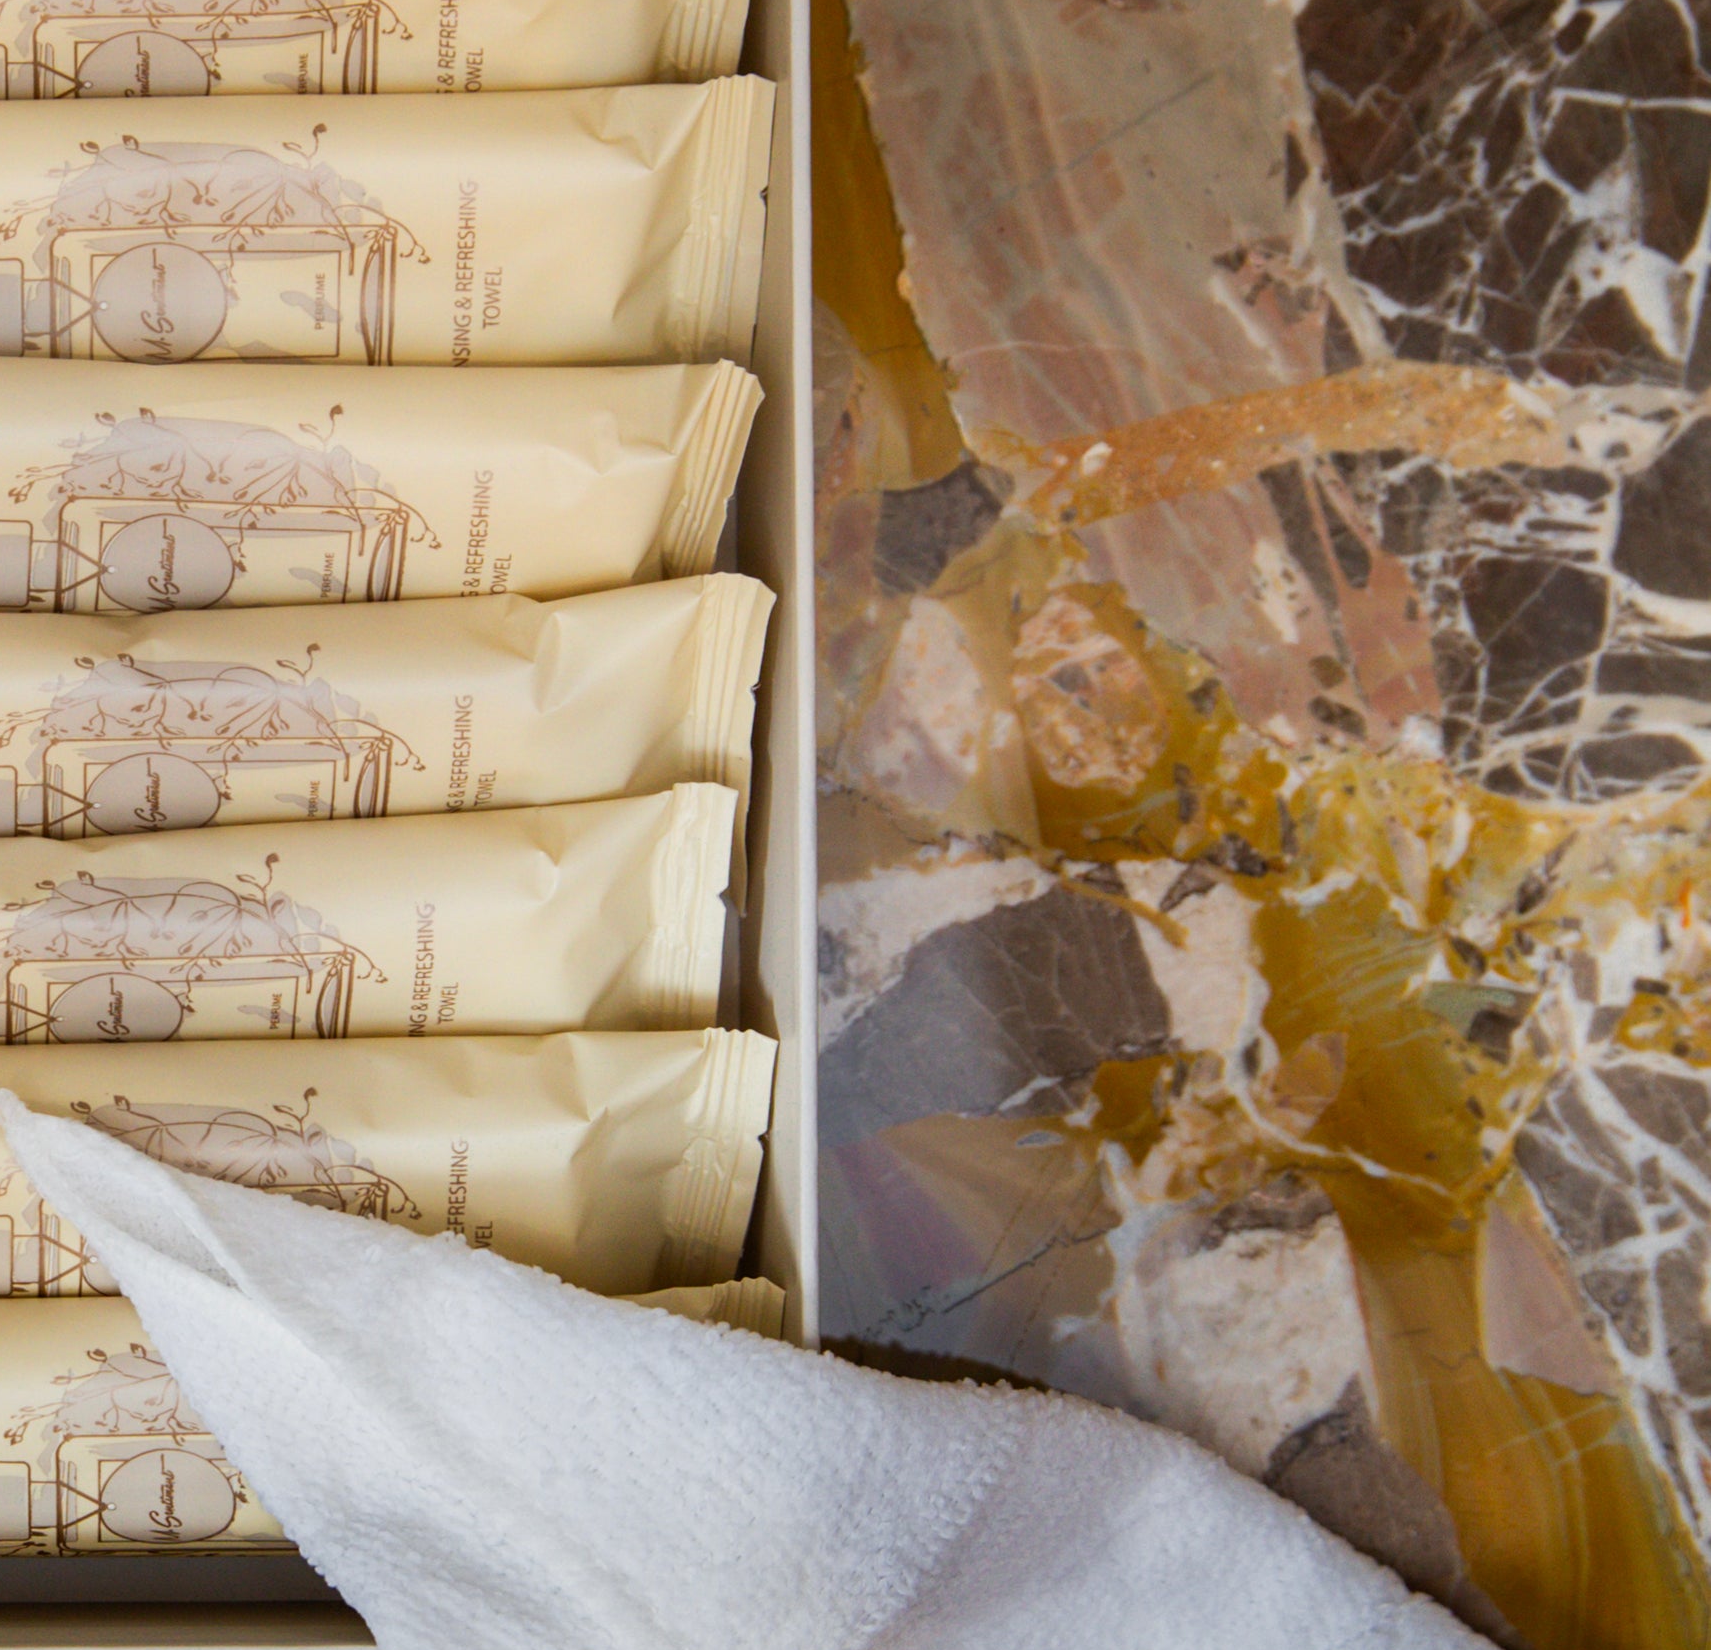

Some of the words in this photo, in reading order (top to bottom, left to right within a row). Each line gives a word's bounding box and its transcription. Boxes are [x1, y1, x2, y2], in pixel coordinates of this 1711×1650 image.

[297, 52, 309, 94] ERFUME
[437, 73, 455, 85] &
[464, 48, 483, 93] OWEL
[454, 181, 479, 292] REFRESHING
[314, 272, 326, 330] PERFUME
[453, 297, 472, 309] &
[482, 267, 502, 329] TOWEL
[464, 470, 493, 574] REFRESHING
[320, 552, 334, 598] PERFUME
[462, 578, 480, 587] &
[490, 554, 512, 595] OWEL
[449, 695, 473, 788] REFRESHING
[307, 780, 320, 817] PERFUME
[448, 790, 466, 798] &
[474, 770, 496, 807] TOWEL
[412, 902, 435, 1000] REFRESHING
[269, 992, 282, 1030] PERFUME
[410, 1003, 428, 1011] &
[437, 982, 458, 1025] TOWEL
[446, 1140, 469, 1235] EFRESHING
